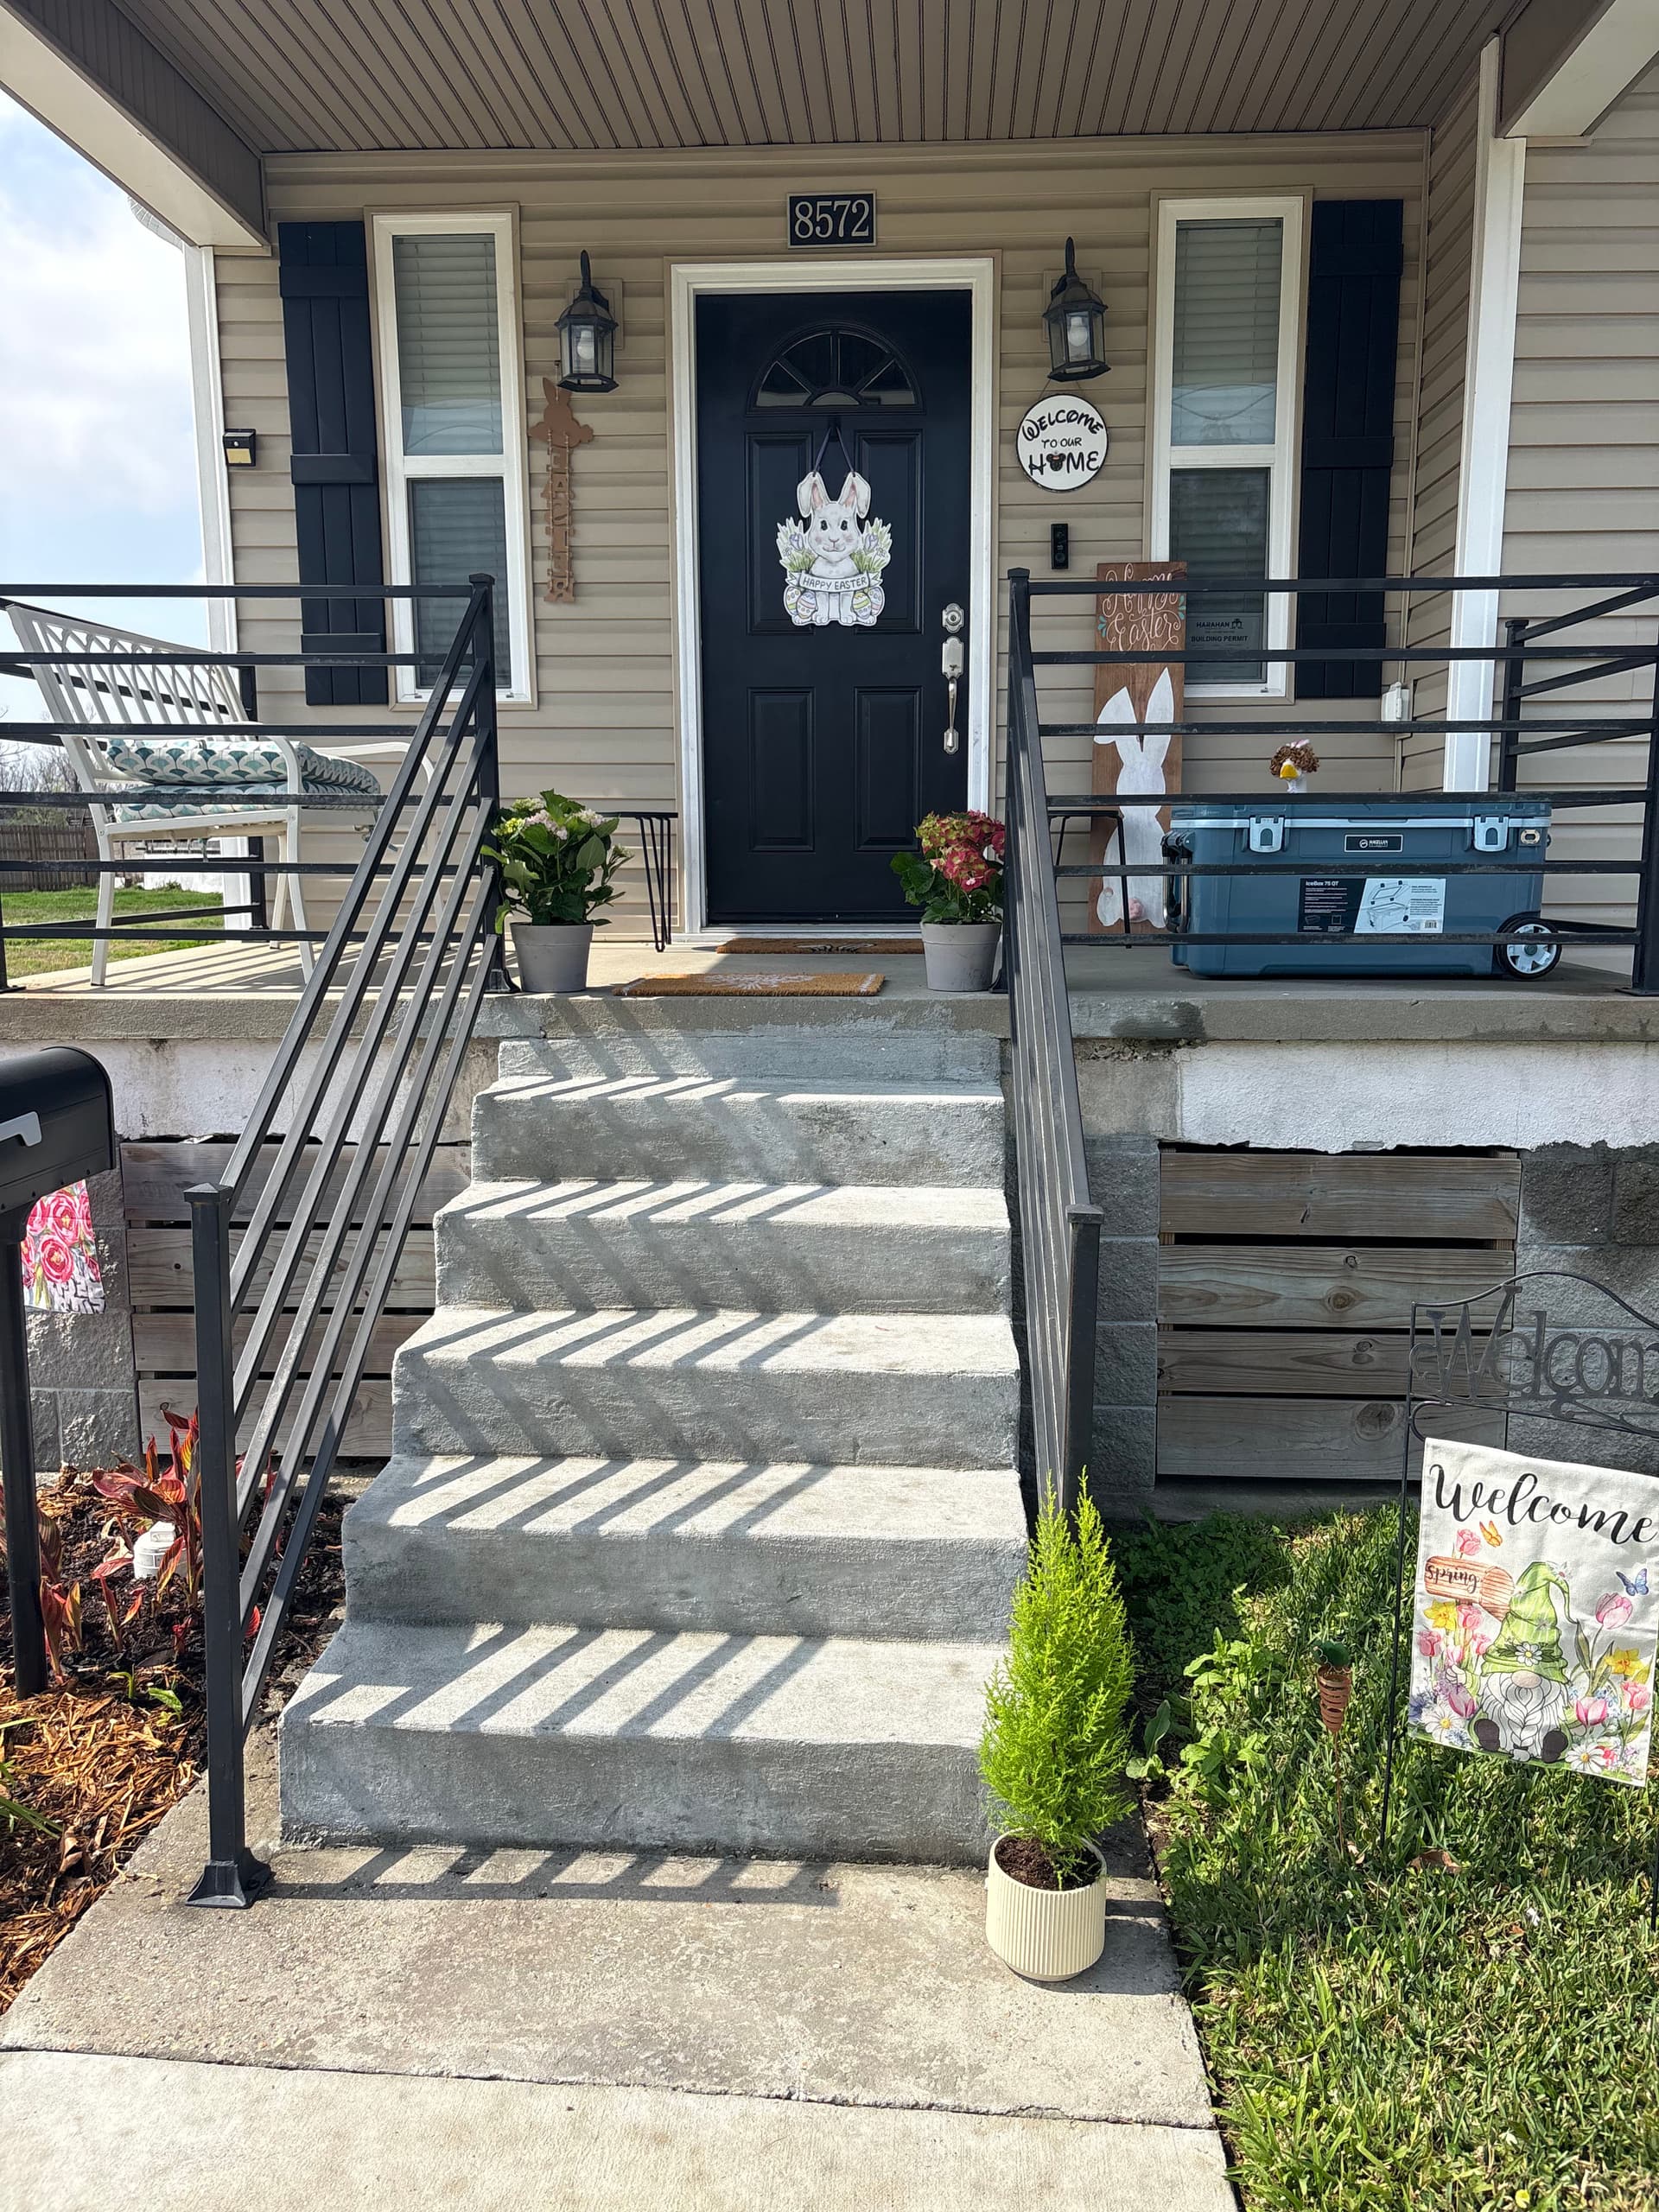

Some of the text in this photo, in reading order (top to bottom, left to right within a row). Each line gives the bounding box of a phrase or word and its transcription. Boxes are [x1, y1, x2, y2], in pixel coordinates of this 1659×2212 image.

[795, 200, 869, 238] 8572
[1021, 409, 1104, 442] WELCOME
[1041, 436, 1083, 449] TO OUR
[802, 575, 868, 589] HAPPY EASTER
[1106, 607, 1181, 652] Easter
[1409, 1285, 1659, 1405] Welcom
[1429, 1464, 1659, 1545] Welcome
